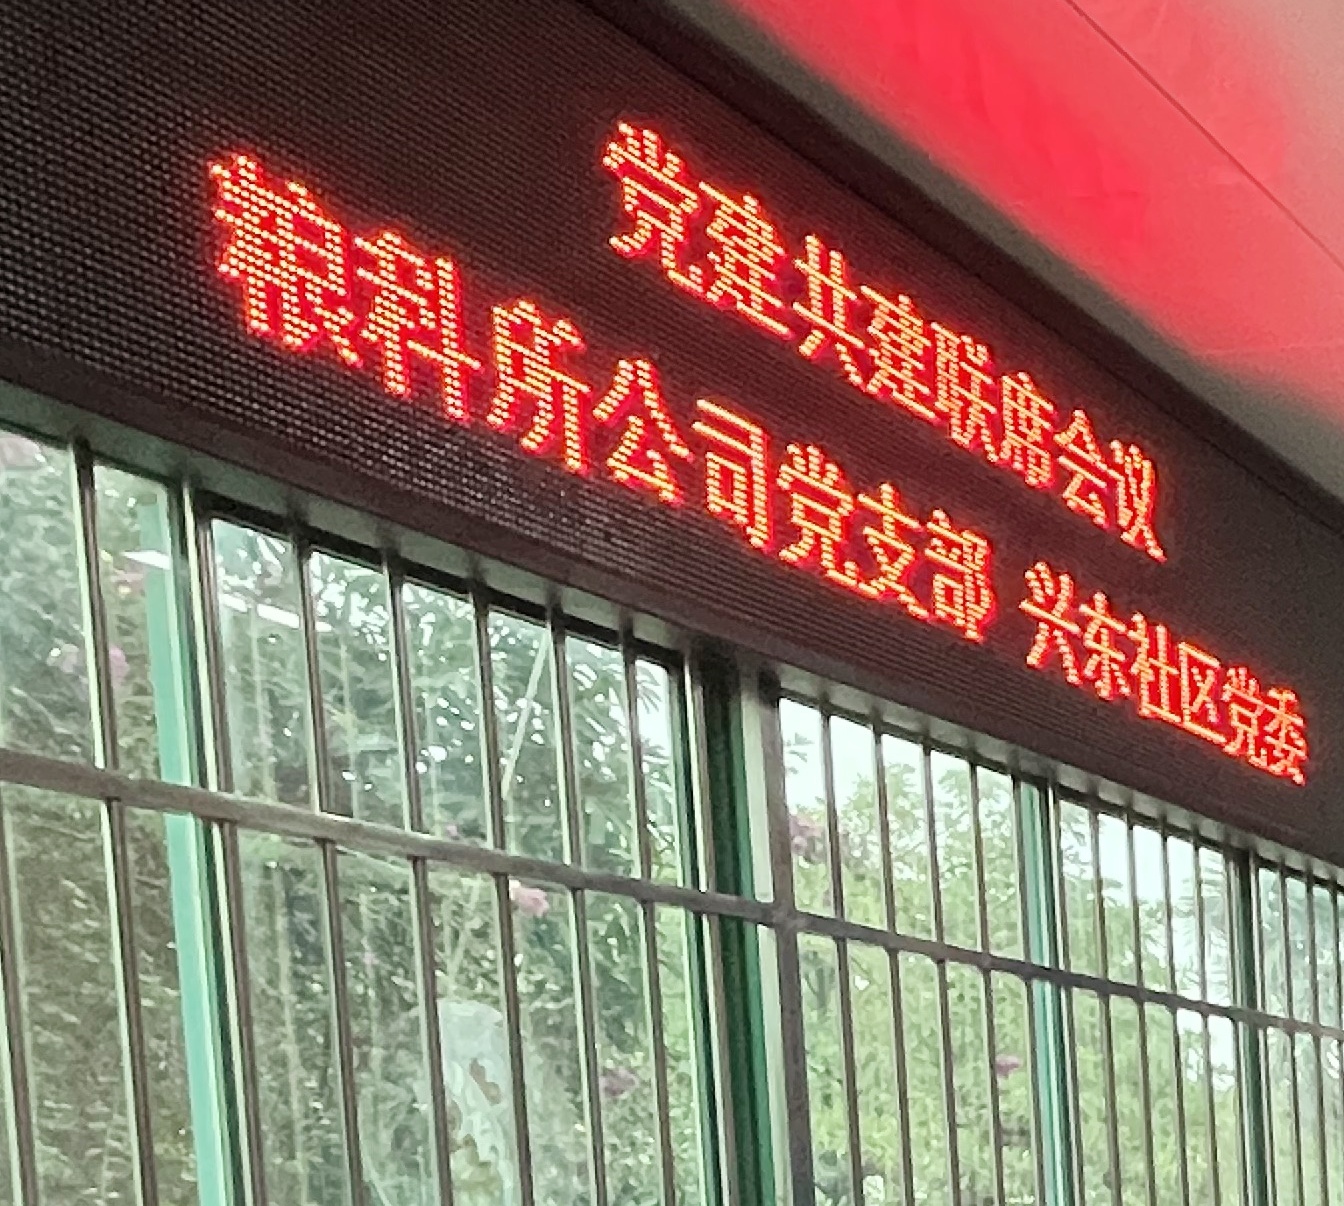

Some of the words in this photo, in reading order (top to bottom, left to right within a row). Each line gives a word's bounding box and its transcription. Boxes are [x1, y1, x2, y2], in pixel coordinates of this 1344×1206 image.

[208, 152, 998, 643] 粮科所公司党支部
[1018, 560, 1309, 785] 兴东社区党委
[603, 121, 1167, 563] 党建共建联席会议
